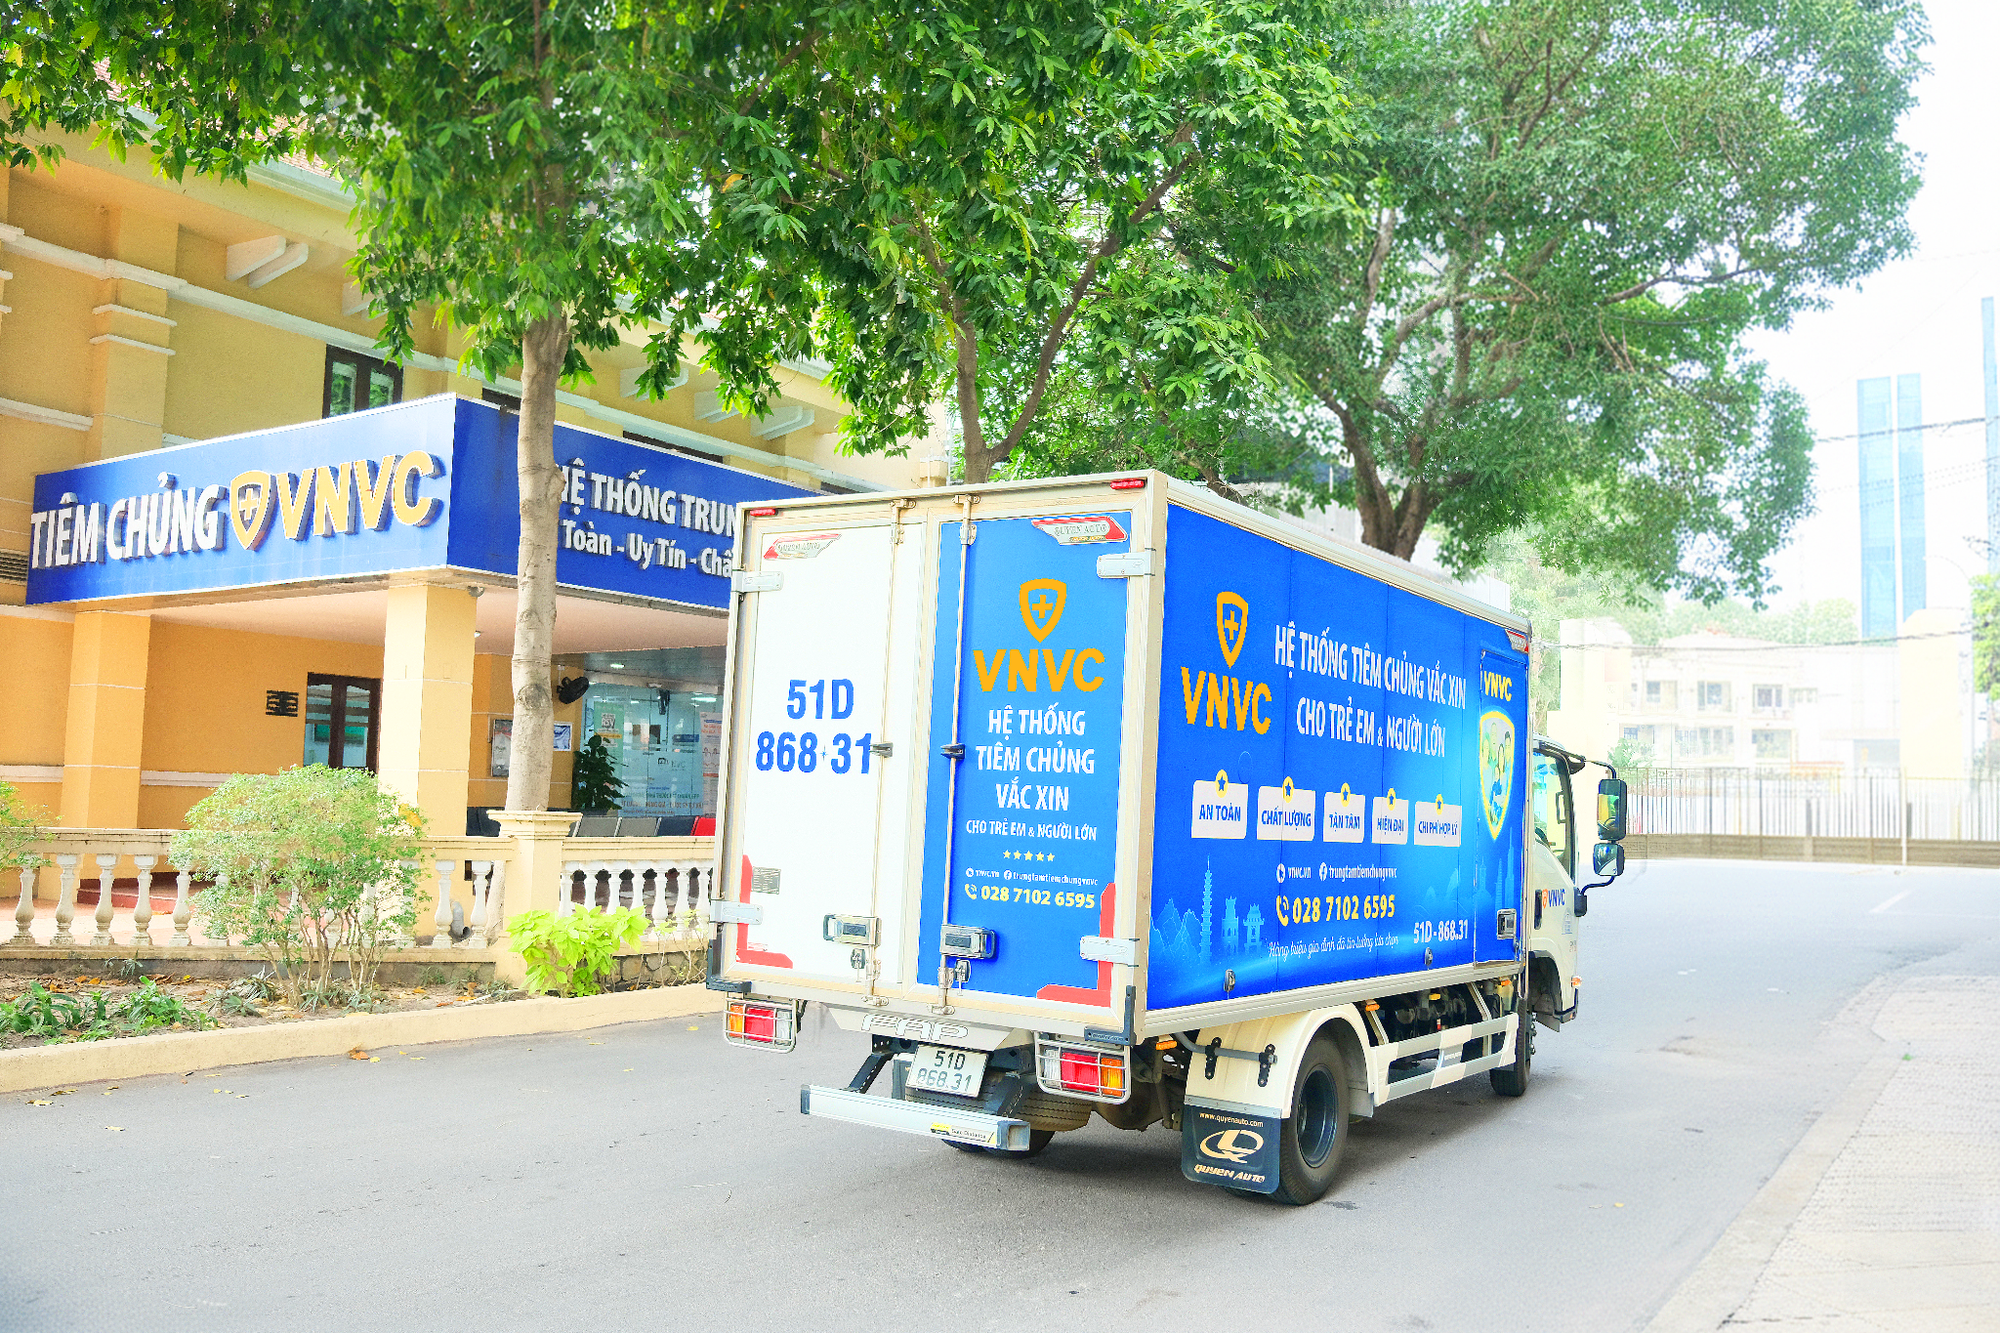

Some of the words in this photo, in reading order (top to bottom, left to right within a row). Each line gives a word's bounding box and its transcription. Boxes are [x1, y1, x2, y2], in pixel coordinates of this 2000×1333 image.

[31, 492, 103, 569] TIÊM
[106, 472, 223, 560] CHỦNG
[276, 450, 440, 540] VNVC
[590, 469, 677, 524] THỐNG
[562, 519, 612, 556] Toàn
[627, 532, 655, 570] Uy
[656, 537, 687, 570] Tín
[973, 648, 1106, 692] VNVC
[1275, 620, 1296, 679] HỆ
[1299, 626, 1348, 681] THỐNG
[1351, 642, 1382, 689] TIÊM
[1384, 650, 1424, 699] CHỦNG
[1427, 660, 1446, 704] VẮC
[1448, 674, 1466, 709] XIN
[787, 678, 854, 719] 51D
[1180, 666, 1272, 735] VNVC
[1484, 670, 1512, 702] VNVC
[988, 704, 1013, 740] HỆ
[1018, 702, 1086, 736] THỐNG
[1296, 696, 1326, 737] CHO
[1329, 696, 1353, 741] TRẺ
[1356, 708, 1375, 746] EM
[1377, 726, 1384, 747] &
[1386, 713, 1423, 754] NGƯỜI
[1425, 718, 1446, 758] LỚN
[976, 741, 1021, 771] TIÊM
[1026, 740, 1095, 774] CHỦNG
[996, 776, 1031, 809] VẮC
[1035, 785, 1069, 811] XIN
[1199, 804, 1213, 820] AN
[1215, 802, 1241, 821] TOÀN
[1261, 805, 1283, 826] CHẤT
[1284, 810, 1312, 831] LƯỢNG
[1329, 811, 1343, 832] TẬN
[1345, 813, 1361, 829] TÂM
[1418, 820, 1429, 834] CHI
[966, 819, 987, 834] CHO
[989, 817, 1009, 836] TRẺ
[1011, 822, 1026, 837] EM
[1028, 826, 1035, 837] &
[1037, 821, 1072, 840] NGƯỜI
[1074, 823, 1098, 841] LỚN
[1287, 866, 1312, 879] vnvc.vn
[981, 885, 1010, 902] 028
[1013, 888, 1051, 905] 7102
[1054, 891, 1096, 909] 6595
[1292, 896, 1321, 924] 028
[1325, 895, 1360, 922] 7102
[1363, 893, 1396, 920] 6595
[1548, 888, 1566, 907] VNVC
[934, 1050, 966, 1070] 51D
[917, 1067, 973, 1092] 868.31
[1199, 1112, 1264, 1127] www.quyenauto.com
[1194, 1163, 1235, 1178] QUYEN
[1233, 1171, 1266, 1183] AUTO
